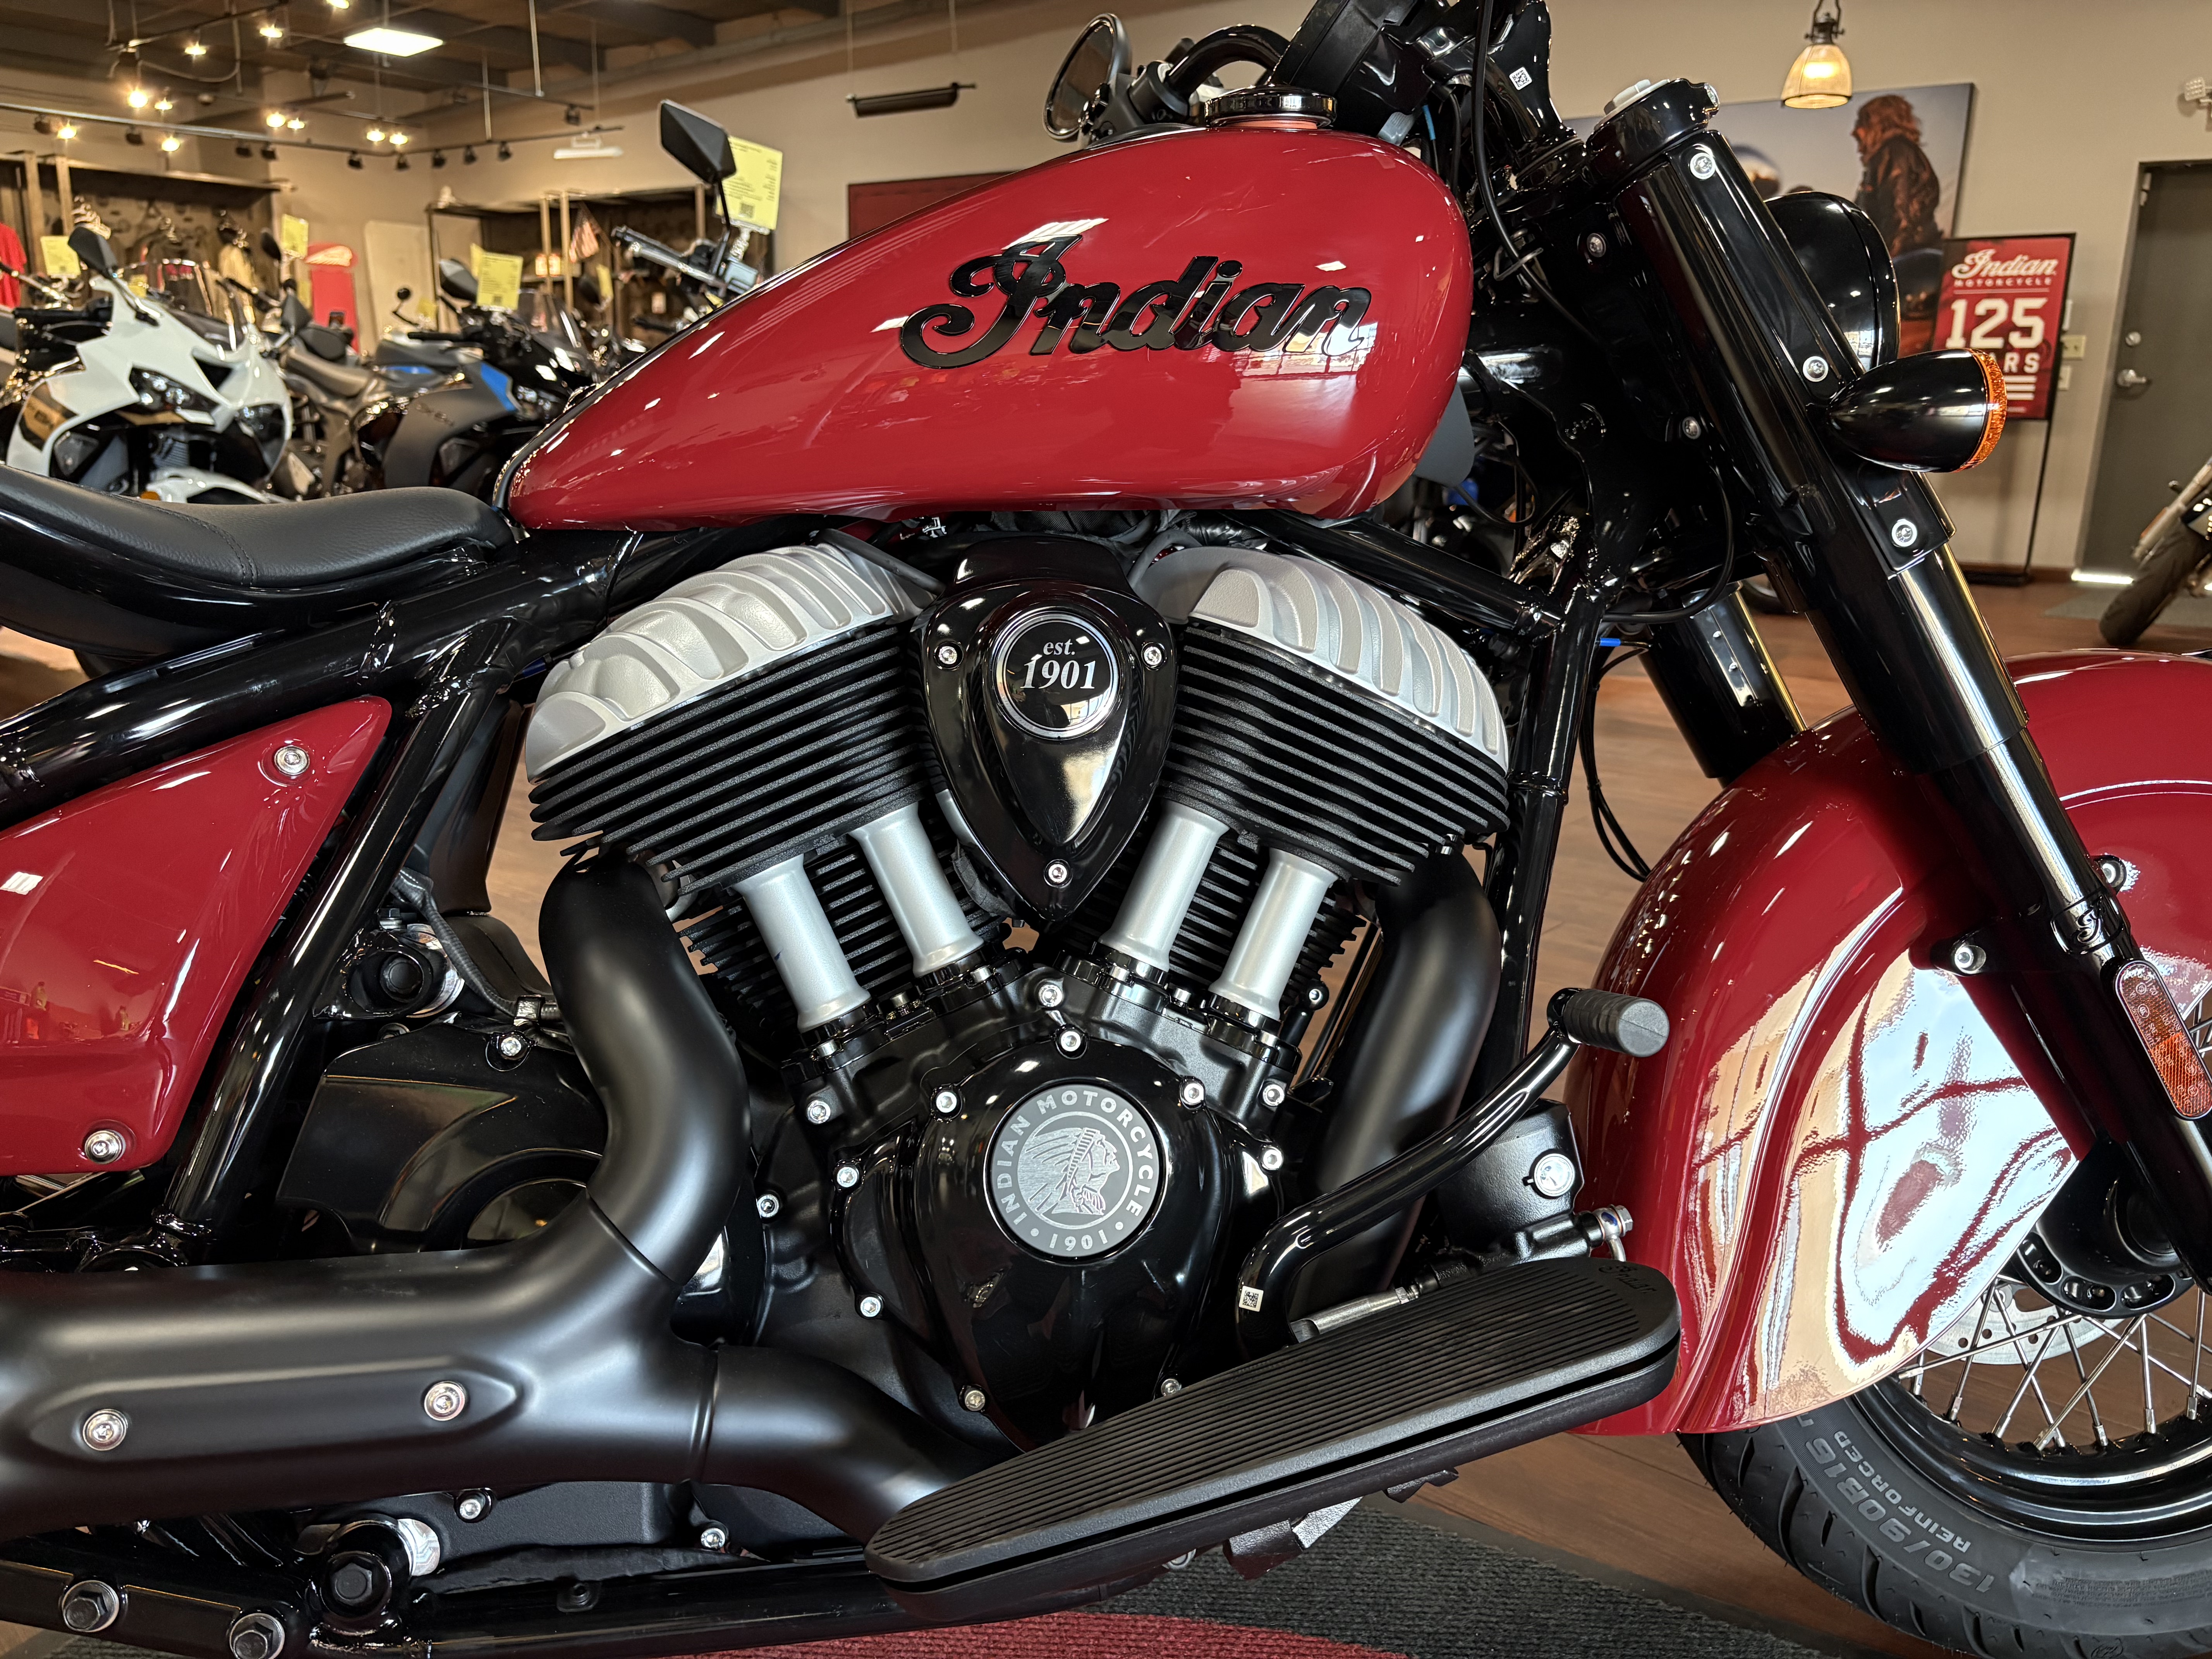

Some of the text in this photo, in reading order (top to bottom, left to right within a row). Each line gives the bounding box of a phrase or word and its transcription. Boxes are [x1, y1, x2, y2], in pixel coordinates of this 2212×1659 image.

[1952, 249, 2058, 279] Indian
[1954, 277, 2052, 287] MOTORCYCLE
[900, 234, 1371, 369] Indian
[1946, 297, 2048, 349] 125
[1043, 639, 1075, 655] est.
[1020, 659, 1096, 689] 1901
[997, 1090, 1154, 1225] INDIAN MOTORCYCLE
[1049, 1229, 1108, 1251] 1901
[1834, 1431, 1971, 1553] REINFORCED
[1805, 1437, 1995, 1592] 130/90B16
